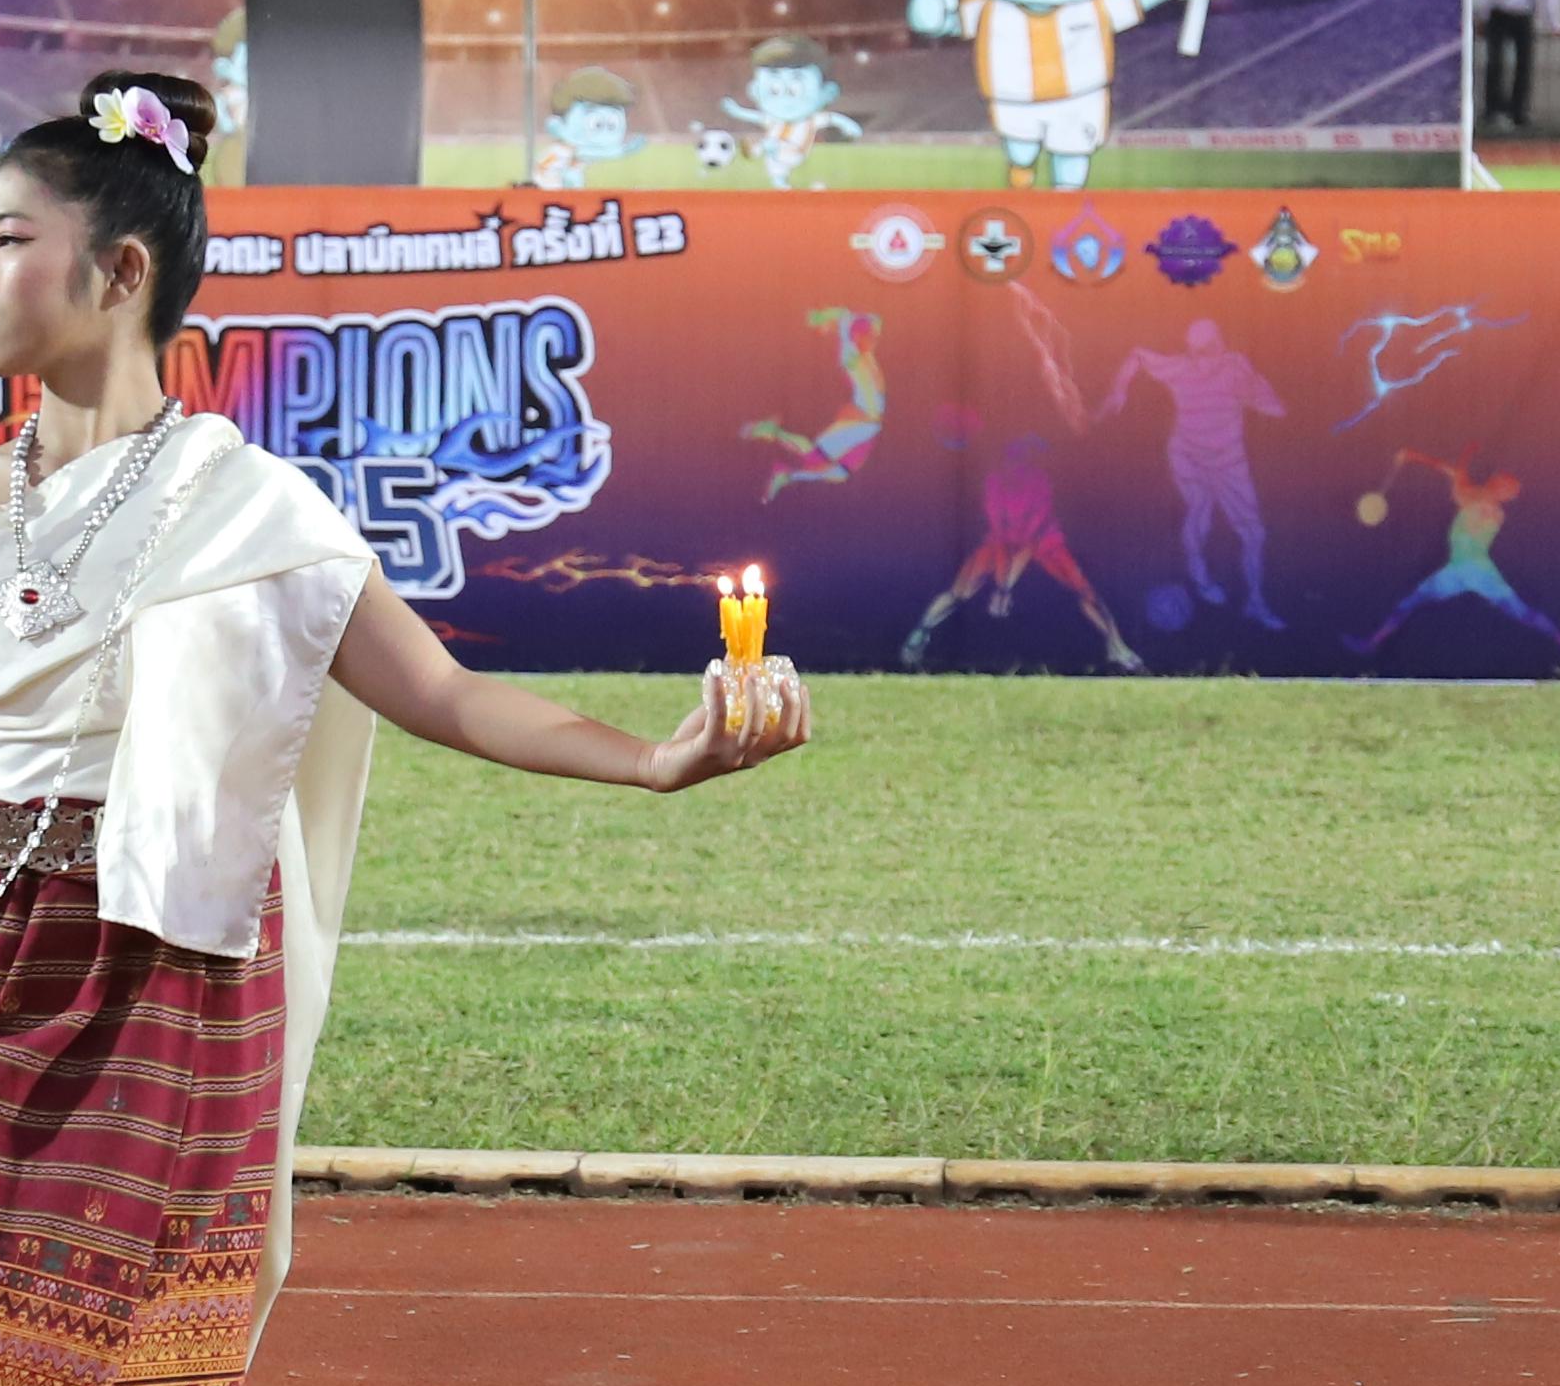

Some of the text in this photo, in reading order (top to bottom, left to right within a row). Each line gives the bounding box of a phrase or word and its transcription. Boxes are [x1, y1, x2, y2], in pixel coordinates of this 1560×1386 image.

[294, 215, 505, 276] ปลาบึกเกมส์
[633, 213, 686, 256] 23
